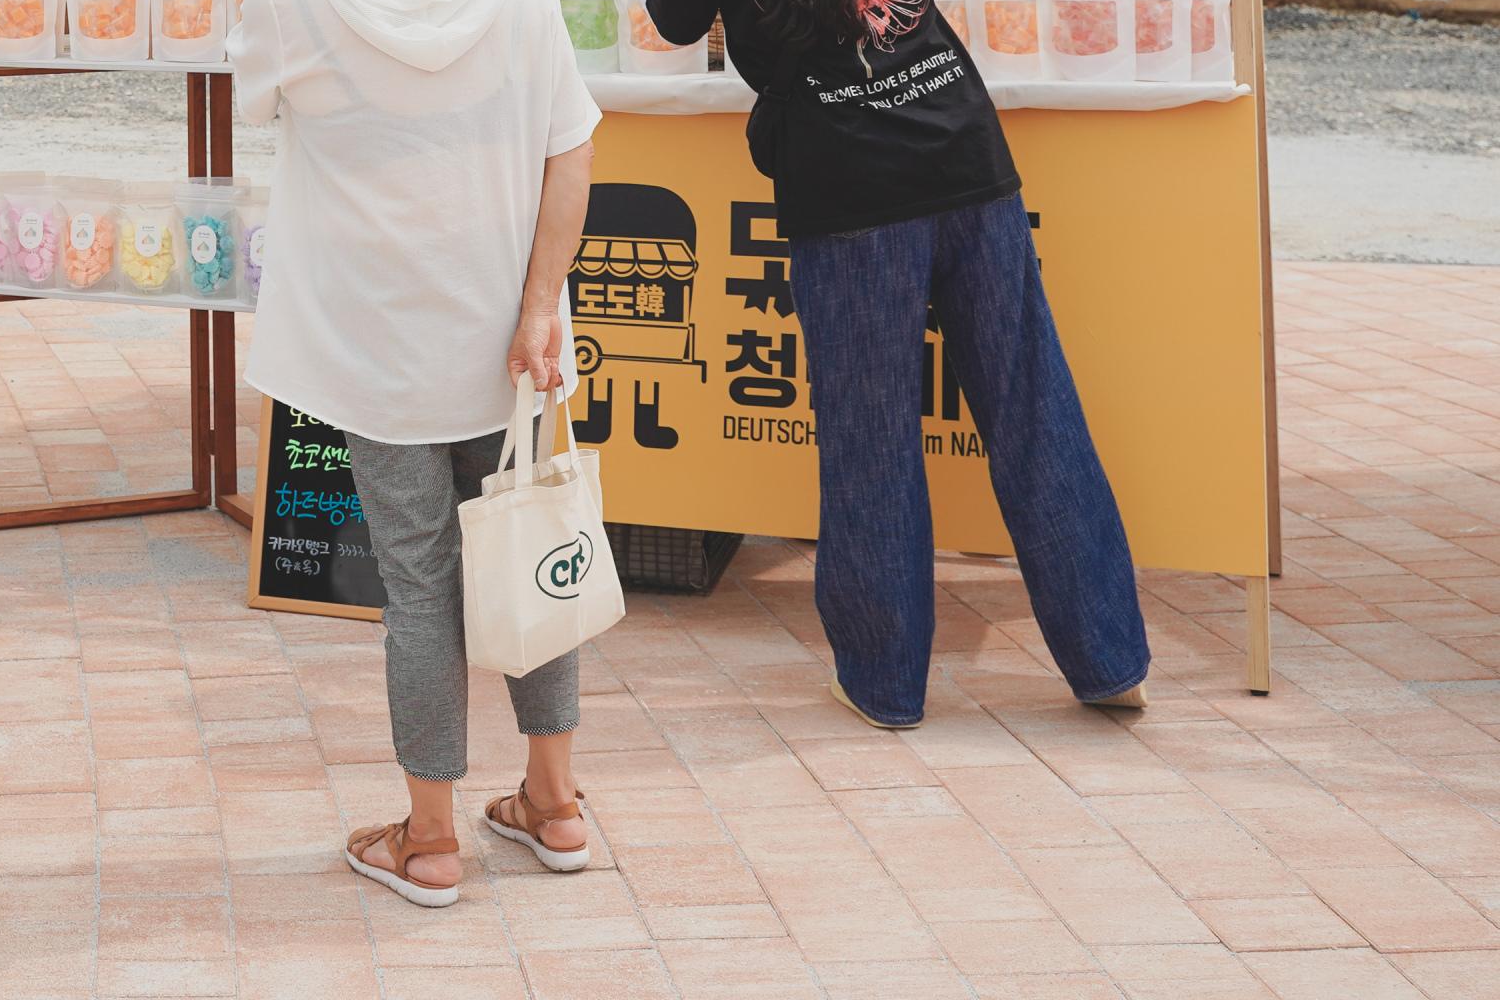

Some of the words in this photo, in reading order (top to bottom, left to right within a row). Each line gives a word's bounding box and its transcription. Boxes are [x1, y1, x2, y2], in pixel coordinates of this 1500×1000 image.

[866, 76, 898, 95] LOVE
[899, 71, 909, 83] IS
[910, 49, 957, 78] BEAUTIFUL
[868, 99, 892, 110] YOU
[894, 83, 927, 106] CAN'T
[926, 70, 955, 92] HAVE
[954, 65, 965, 77] IT
[576, 282, 666, 318] 도도韓
